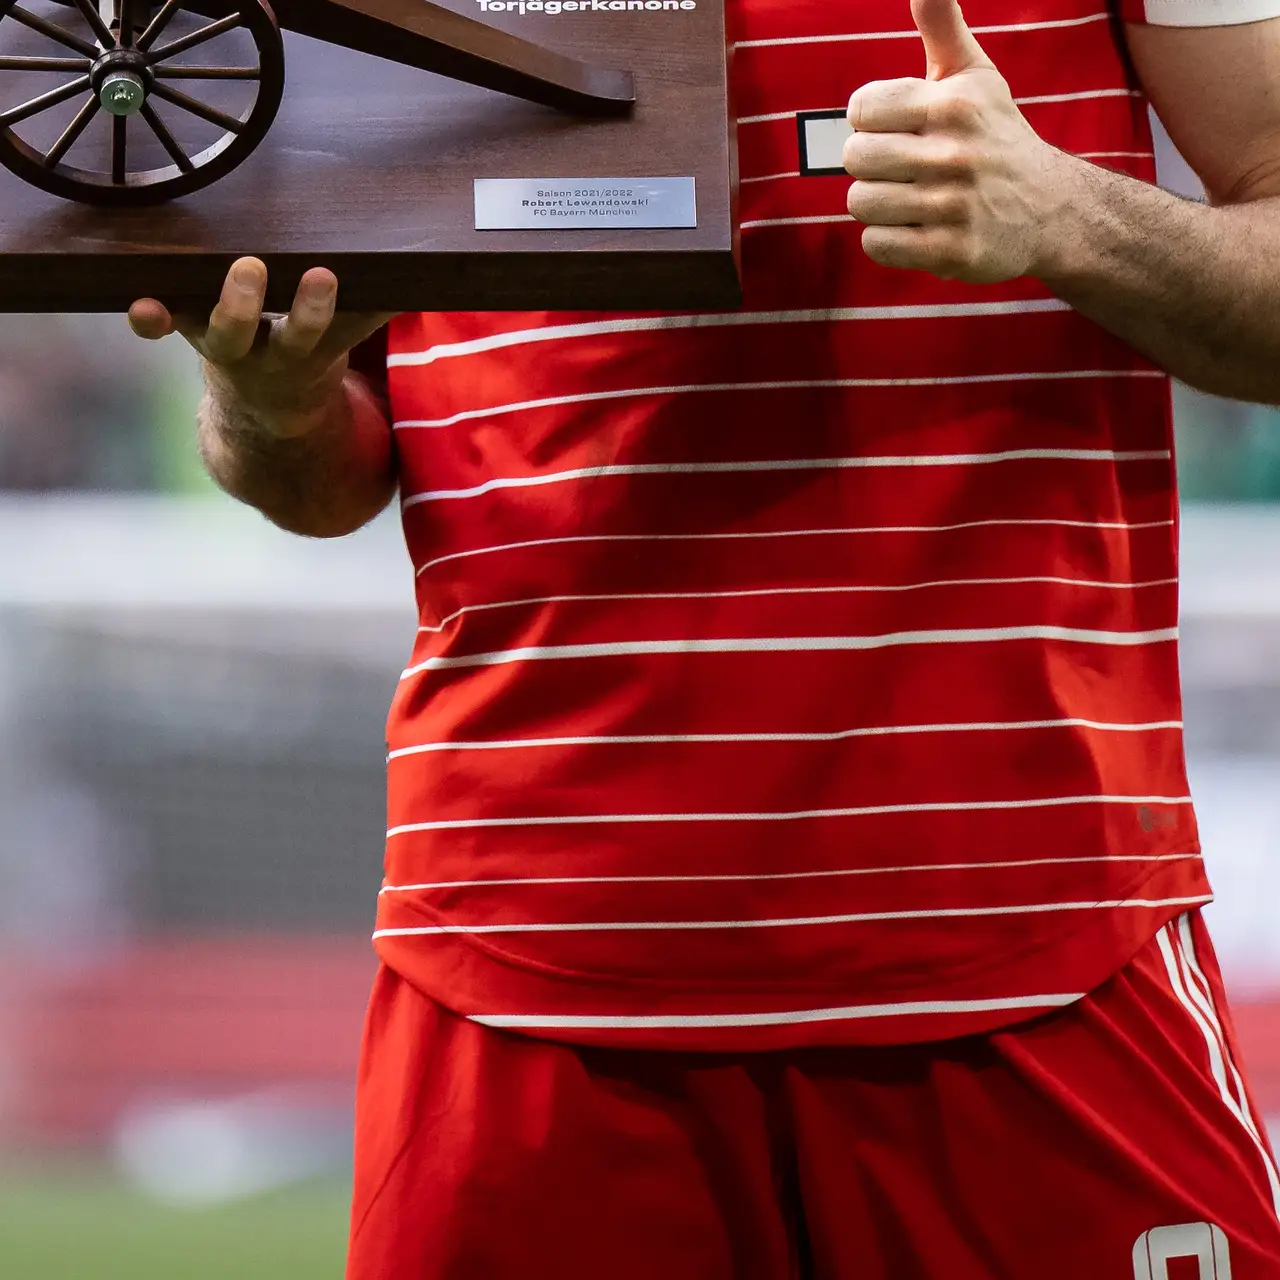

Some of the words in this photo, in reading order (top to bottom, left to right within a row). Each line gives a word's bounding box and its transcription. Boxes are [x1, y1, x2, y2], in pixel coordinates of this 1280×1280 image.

[537, 189, 572, 197] Saison
[574, 189, 634, 197] 2021/2022
[521, 199, 564, 207] Robert
[566, 198, 649, 207] Lewandowski
[549, 208, 586, 217] Bayern
[588, 208, 639, 216] München
